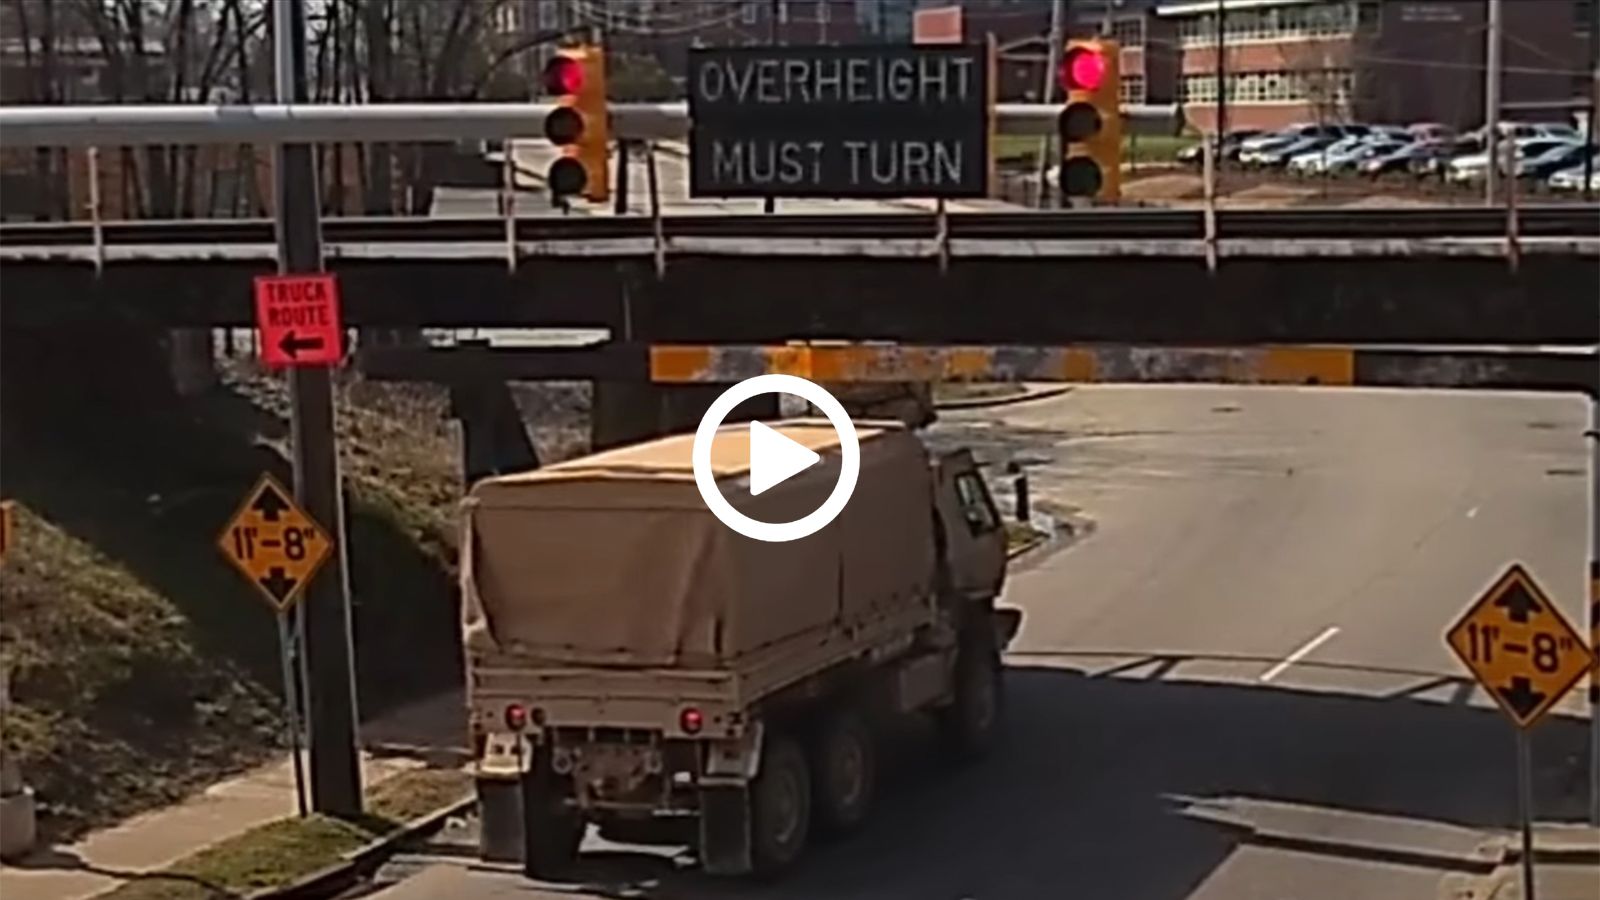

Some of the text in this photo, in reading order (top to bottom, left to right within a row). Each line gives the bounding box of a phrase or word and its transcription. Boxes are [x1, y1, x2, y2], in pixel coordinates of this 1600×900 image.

[700, 57, 973, 102] OVERHEIGHT
[712, 140, 962, 184] MUST TURN
[266, 282, 326, 302] TRUCK
[268, 305, 328, 326] ROUTE
